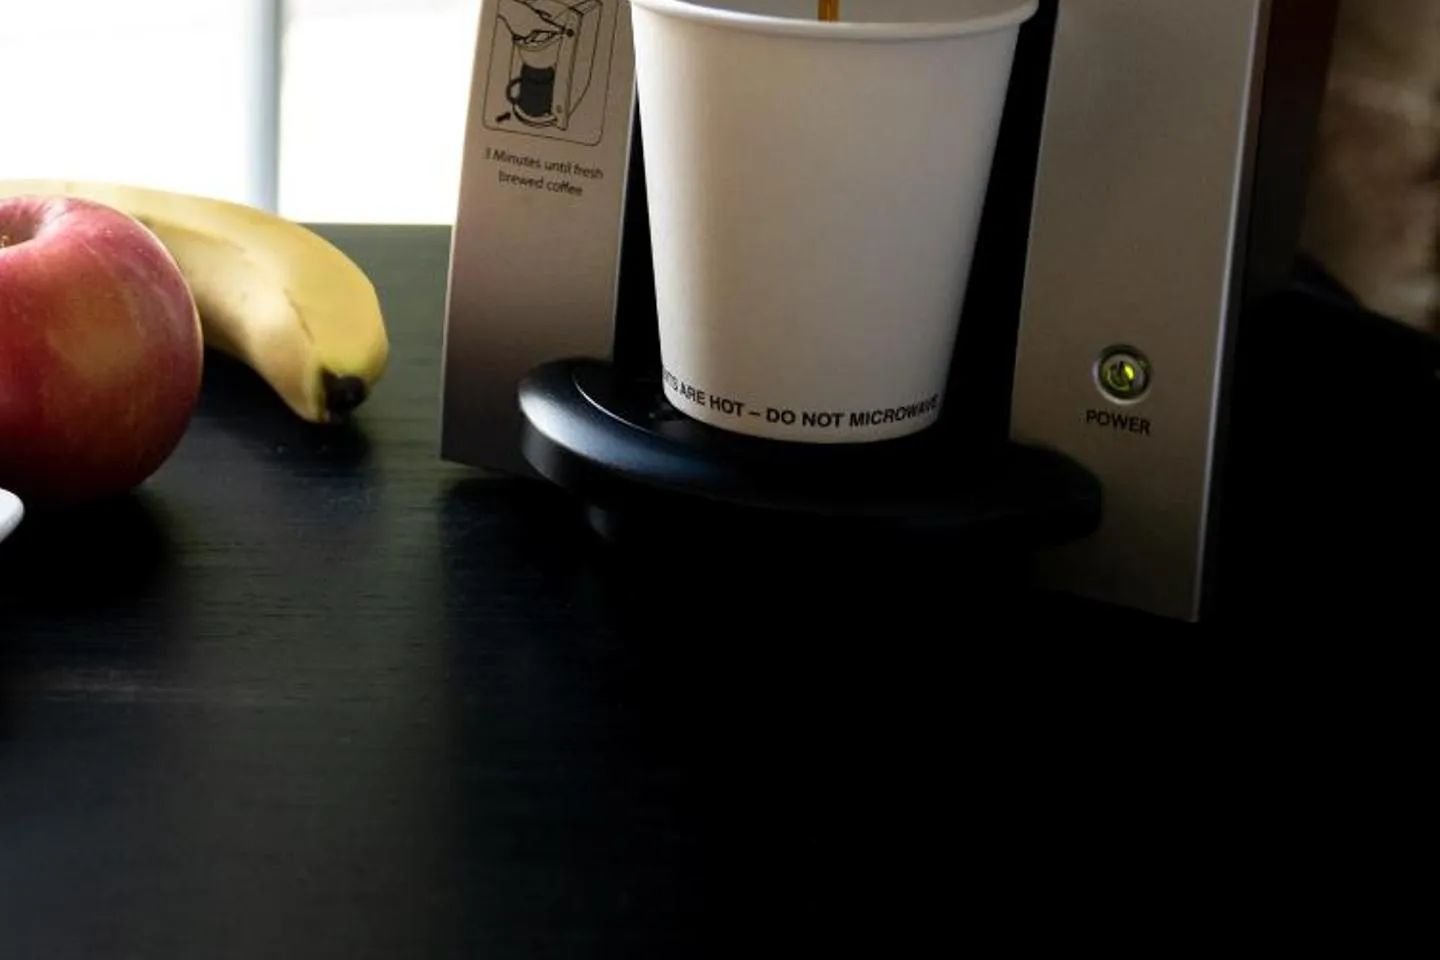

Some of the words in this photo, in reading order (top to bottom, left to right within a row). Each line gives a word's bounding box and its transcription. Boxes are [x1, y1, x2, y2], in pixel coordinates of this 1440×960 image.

[492, 149, 541, 169] Minutes
[544, 160, 571, 175] until
[573, 163, 604, 179] fresh
[498, 170, 544, 189] brewed
[546, 180, 583, 197] coffee
[679, 381, 706, 406] ARE
[708, 394, 745, 417] HOT
[766, 407, 796, 425] DO
[801, 410, 845, 428] NOT
[849, 393, 939, 428] MICROWAVE
[1085, 408, 1152, 437] POWER
